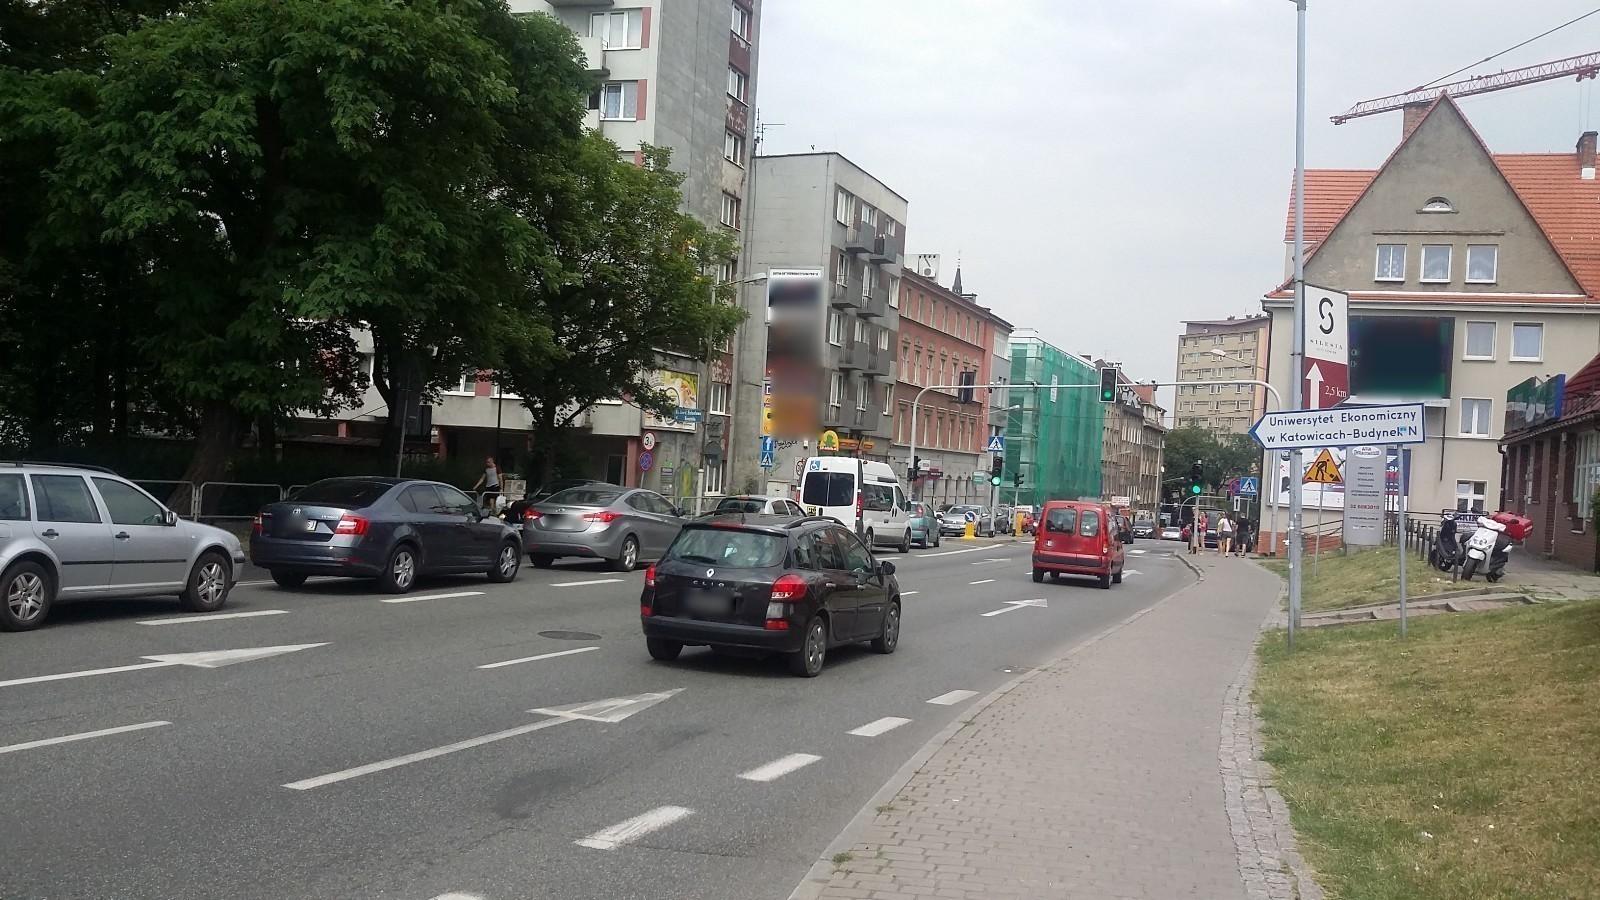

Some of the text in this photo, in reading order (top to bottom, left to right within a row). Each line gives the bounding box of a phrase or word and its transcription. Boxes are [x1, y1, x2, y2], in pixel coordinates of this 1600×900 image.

[1309, 339, 1344, 350] SILESIA
[1325, 385, 1347, 398] 2,5 km
[1269, 410, 1417, 428] Uniwersytet Ekonomiczny
[1408, 426, 1417, 436] N
